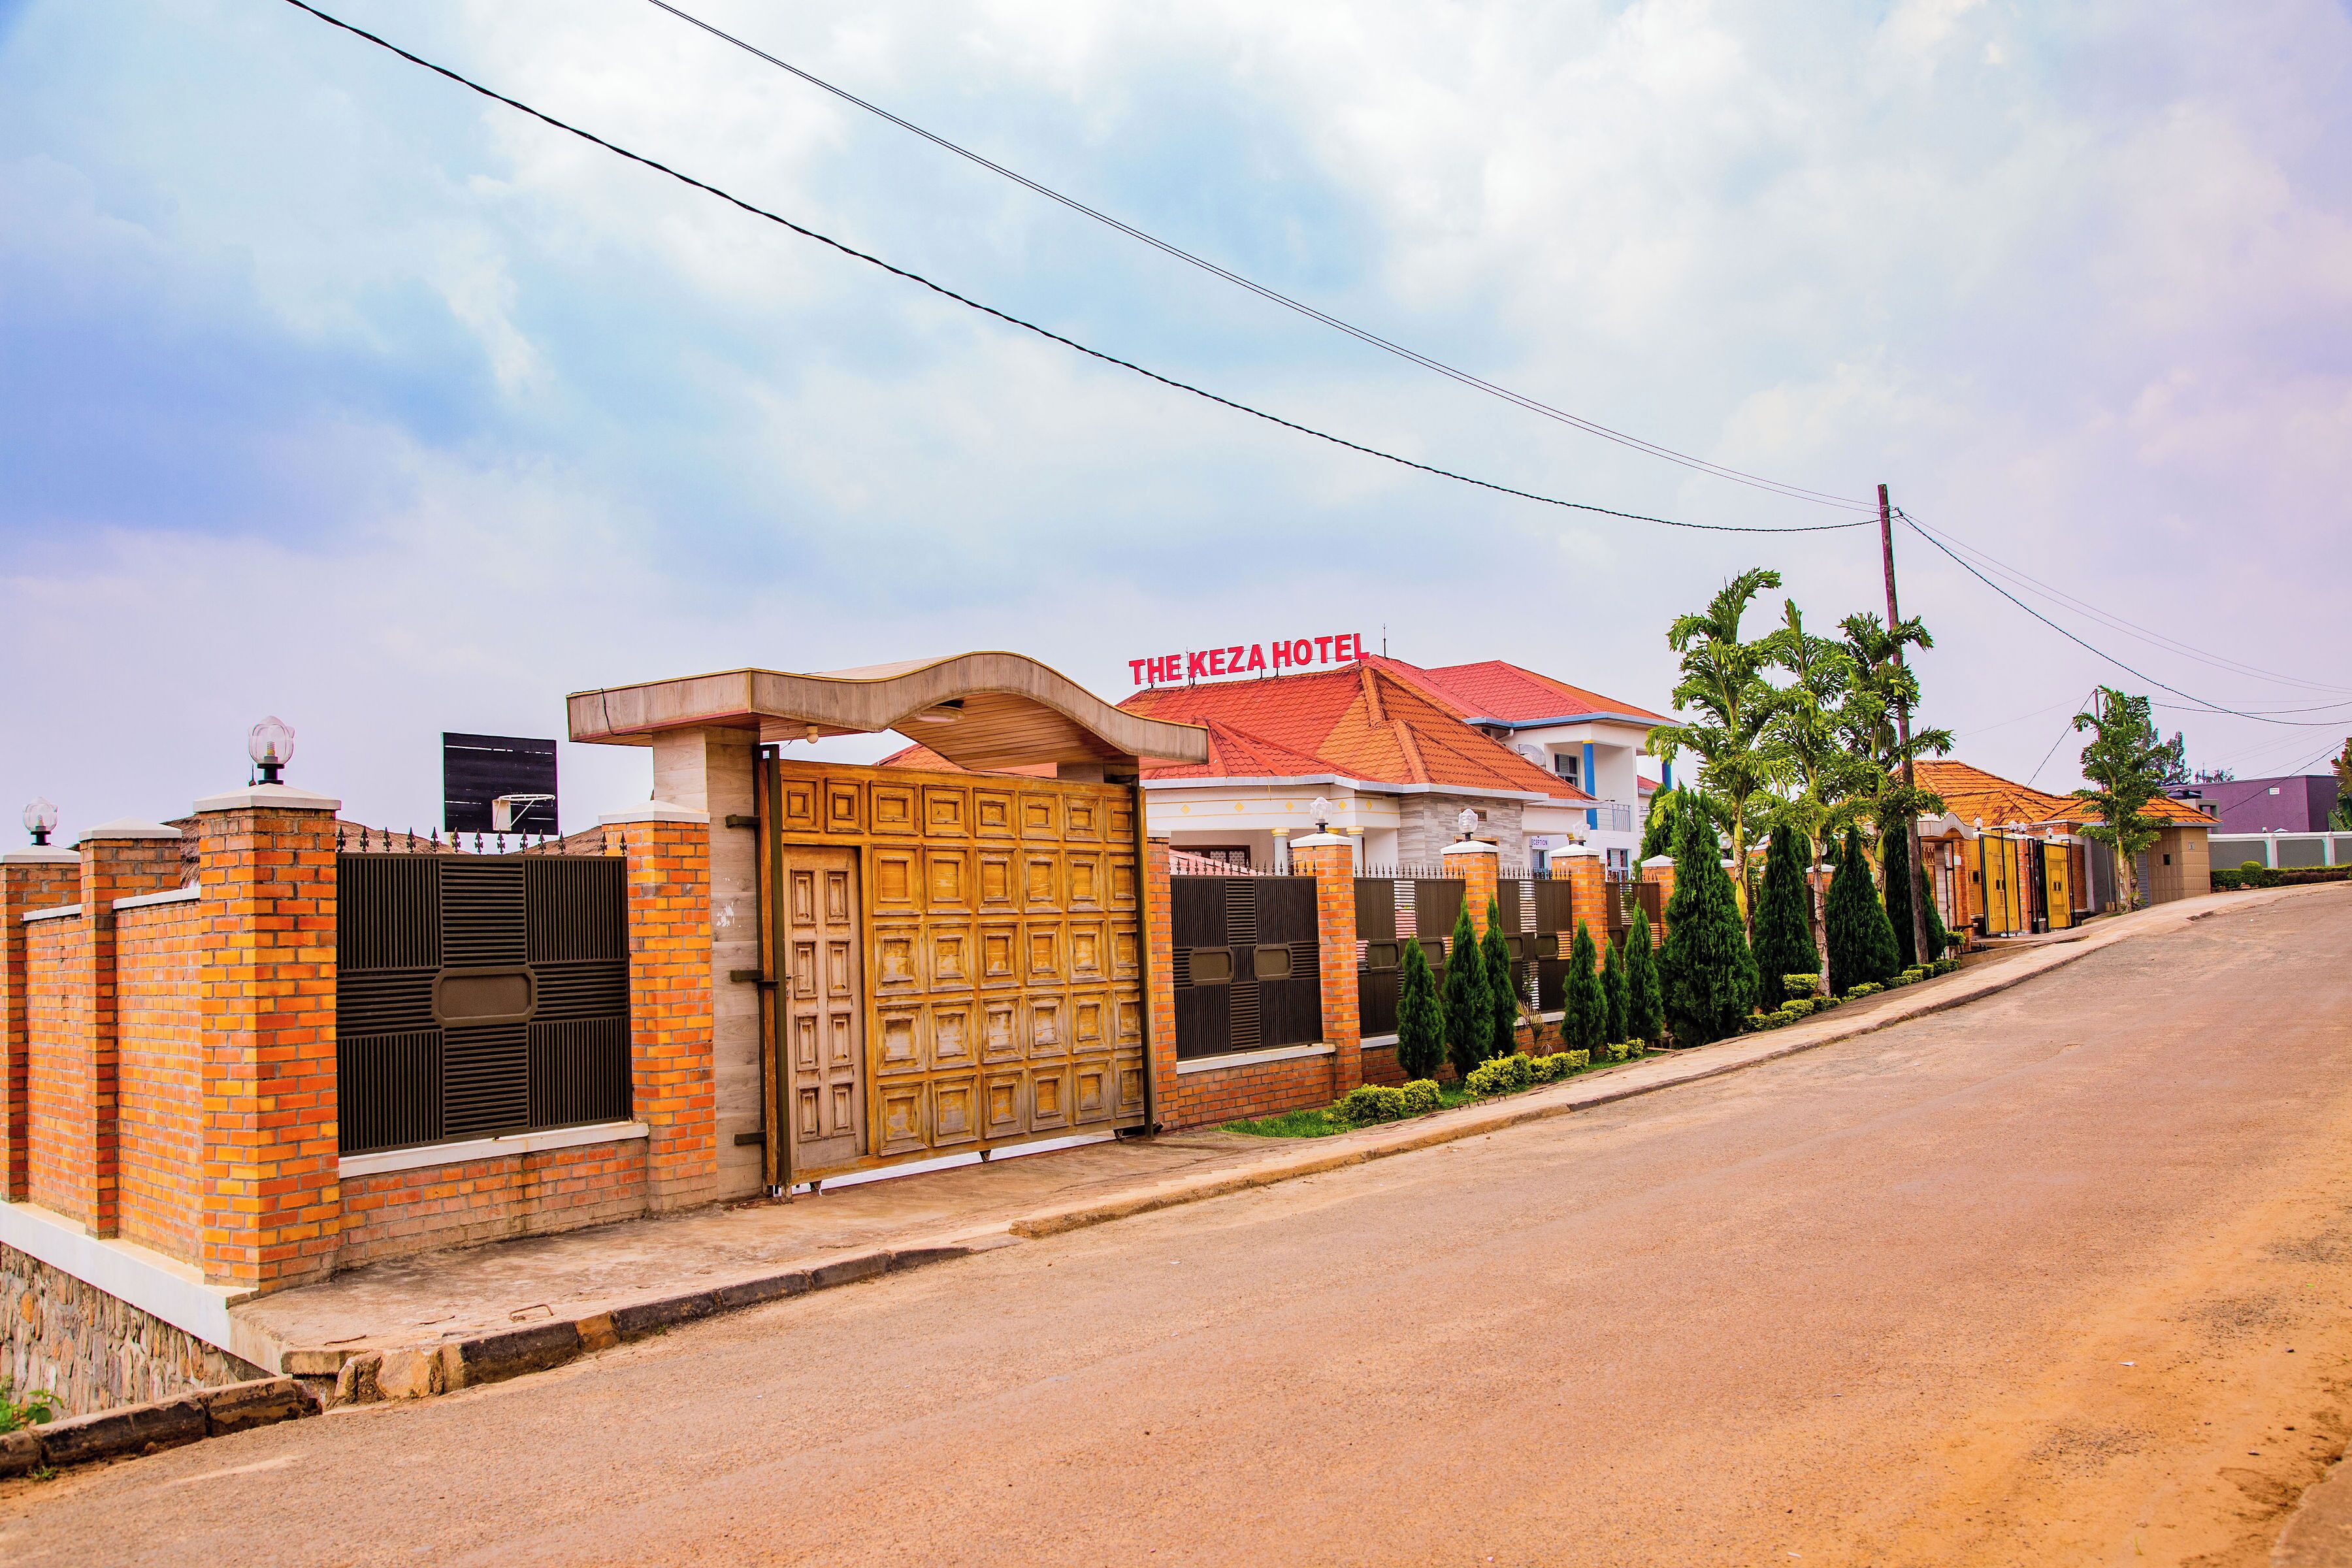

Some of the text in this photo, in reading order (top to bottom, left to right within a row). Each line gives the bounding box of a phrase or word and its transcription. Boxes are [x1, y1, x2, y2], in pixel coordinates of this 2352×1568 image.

[1129, 633, 1370, 685] THE KEZA HOTEL
